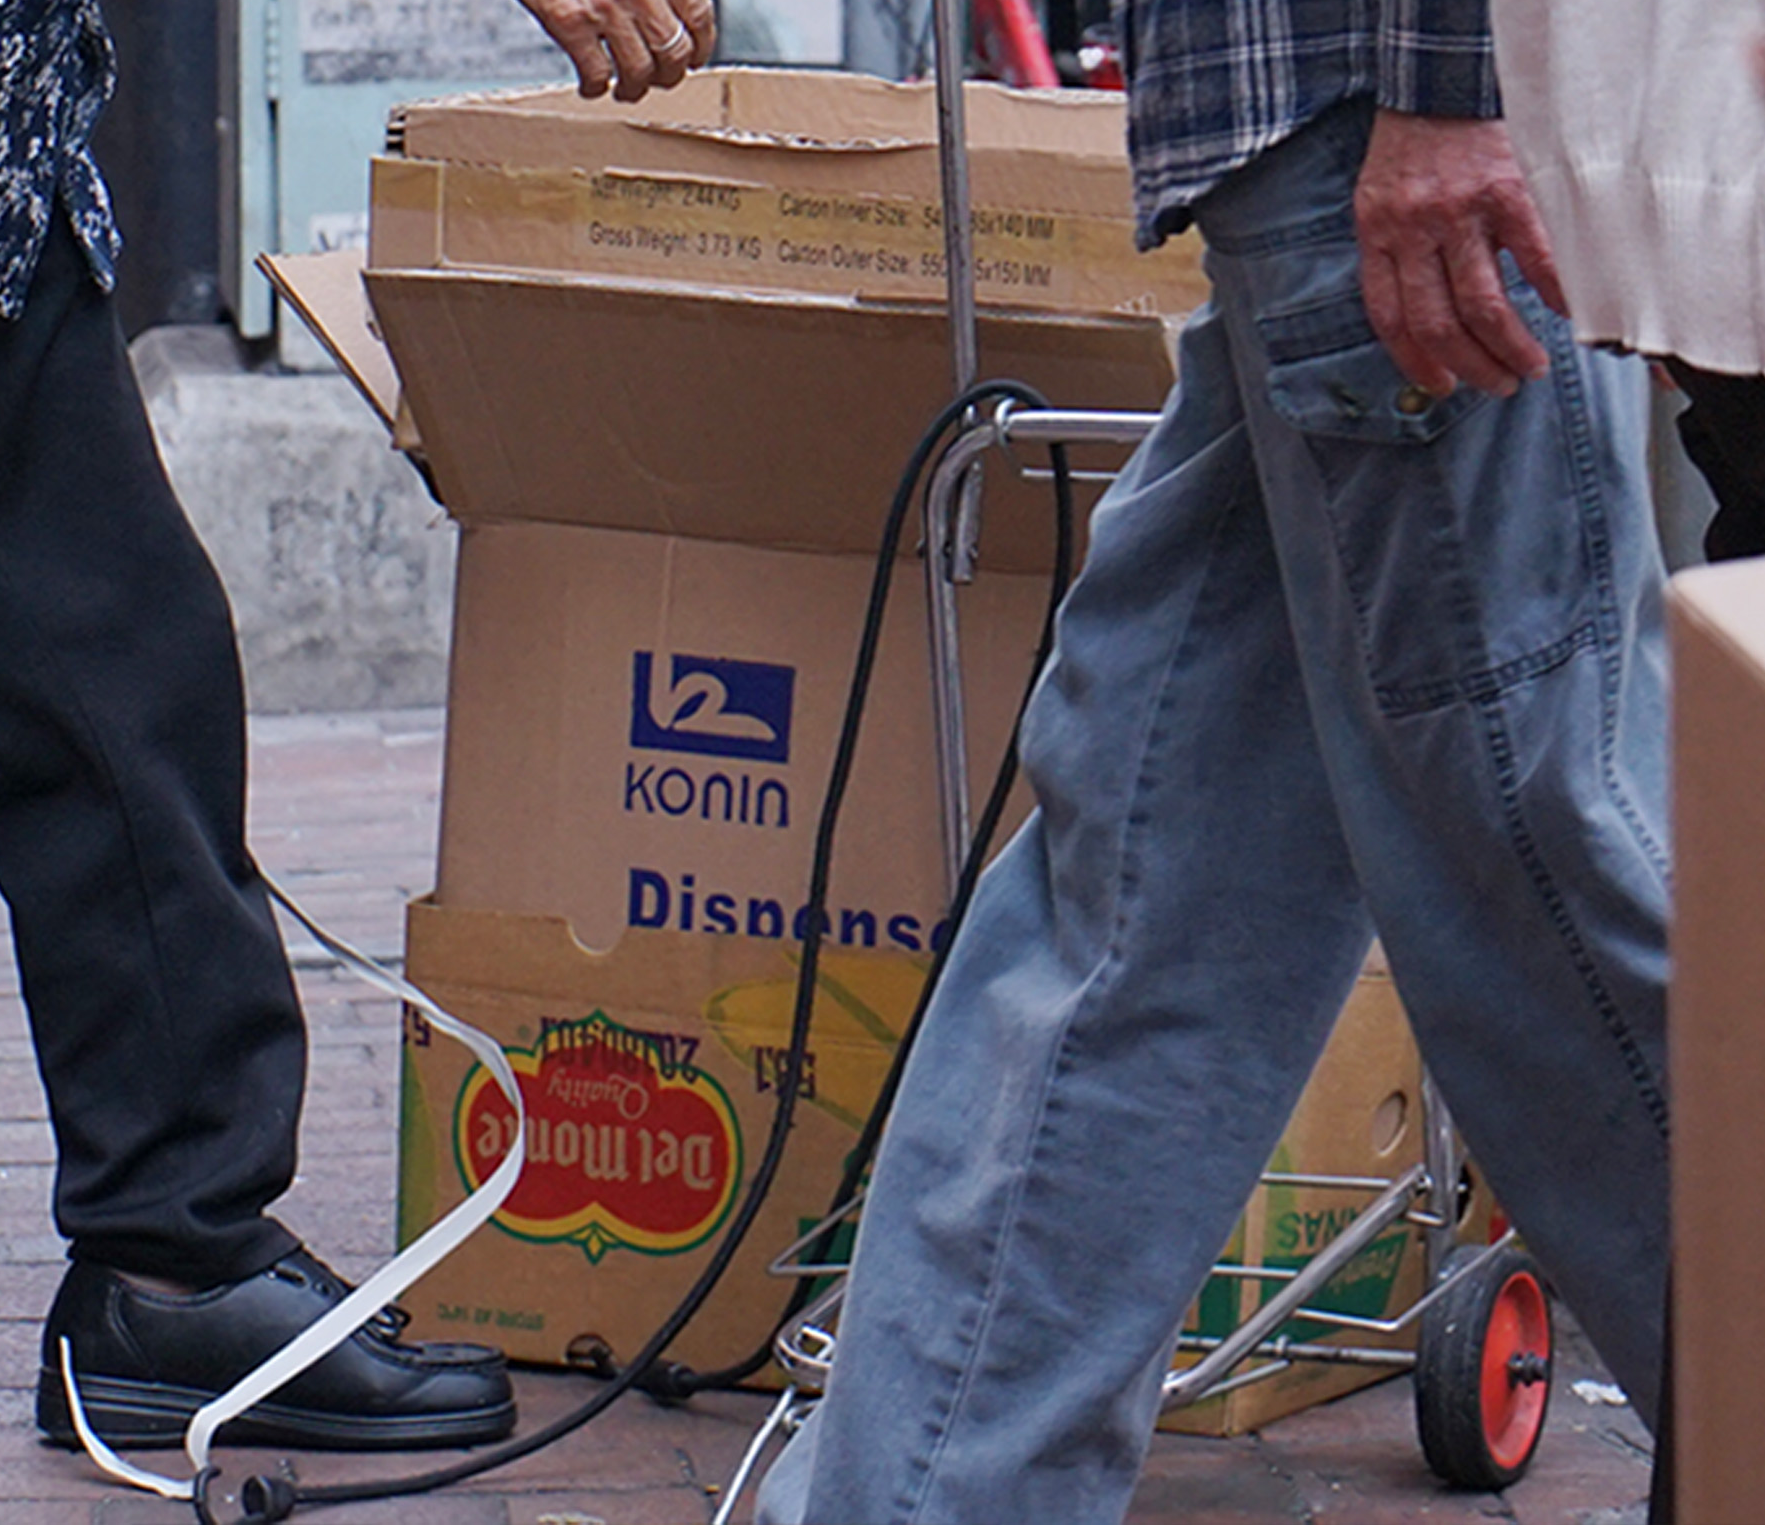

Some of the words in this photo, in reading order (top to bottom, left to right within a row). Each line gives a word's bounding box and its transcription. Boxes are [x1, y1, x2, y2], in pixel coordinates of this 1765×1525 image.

[546, 1068, 649, 1121] Quality
[476, 1111, 631, 1181] Monte
[637, 1129, 715, 1191] Del
